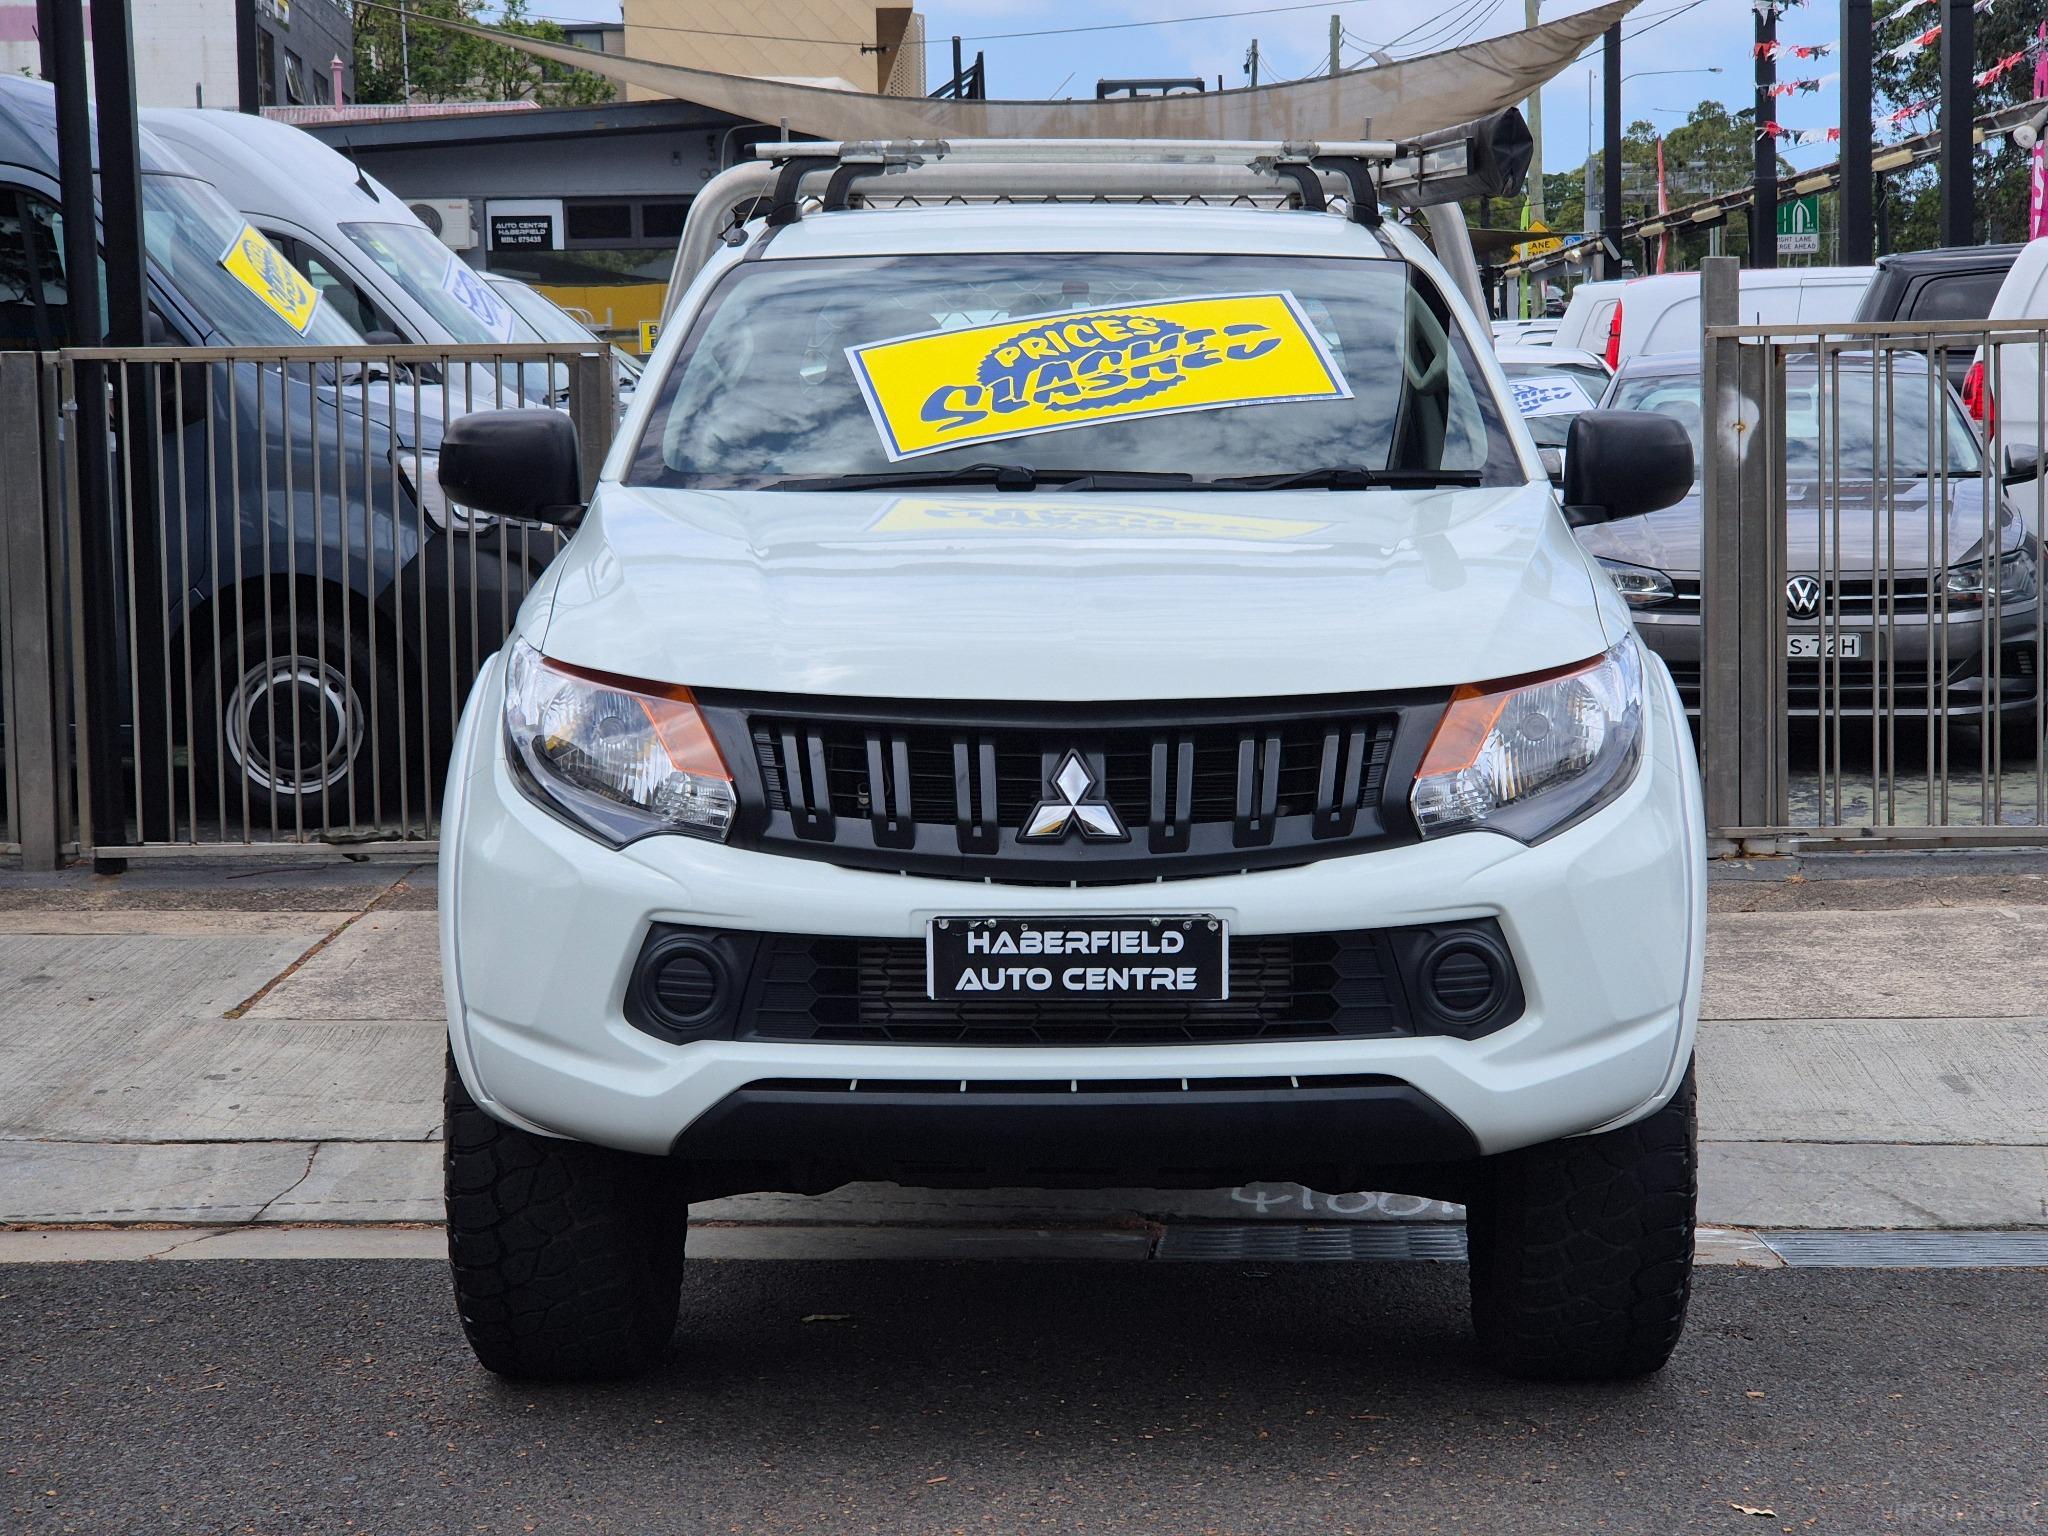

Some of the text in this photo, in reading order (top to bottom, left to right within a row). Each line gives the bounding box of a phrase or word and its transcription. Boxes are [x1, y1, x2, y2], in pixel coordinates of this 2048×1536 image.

[995, 318, 1161, 367] PRICES
[920, 323, 1282, 432] SLASHED
[967, 930, 1185, 954] HABERFIELD
[954, 967, 1198, 991] AUTO CENTRE
